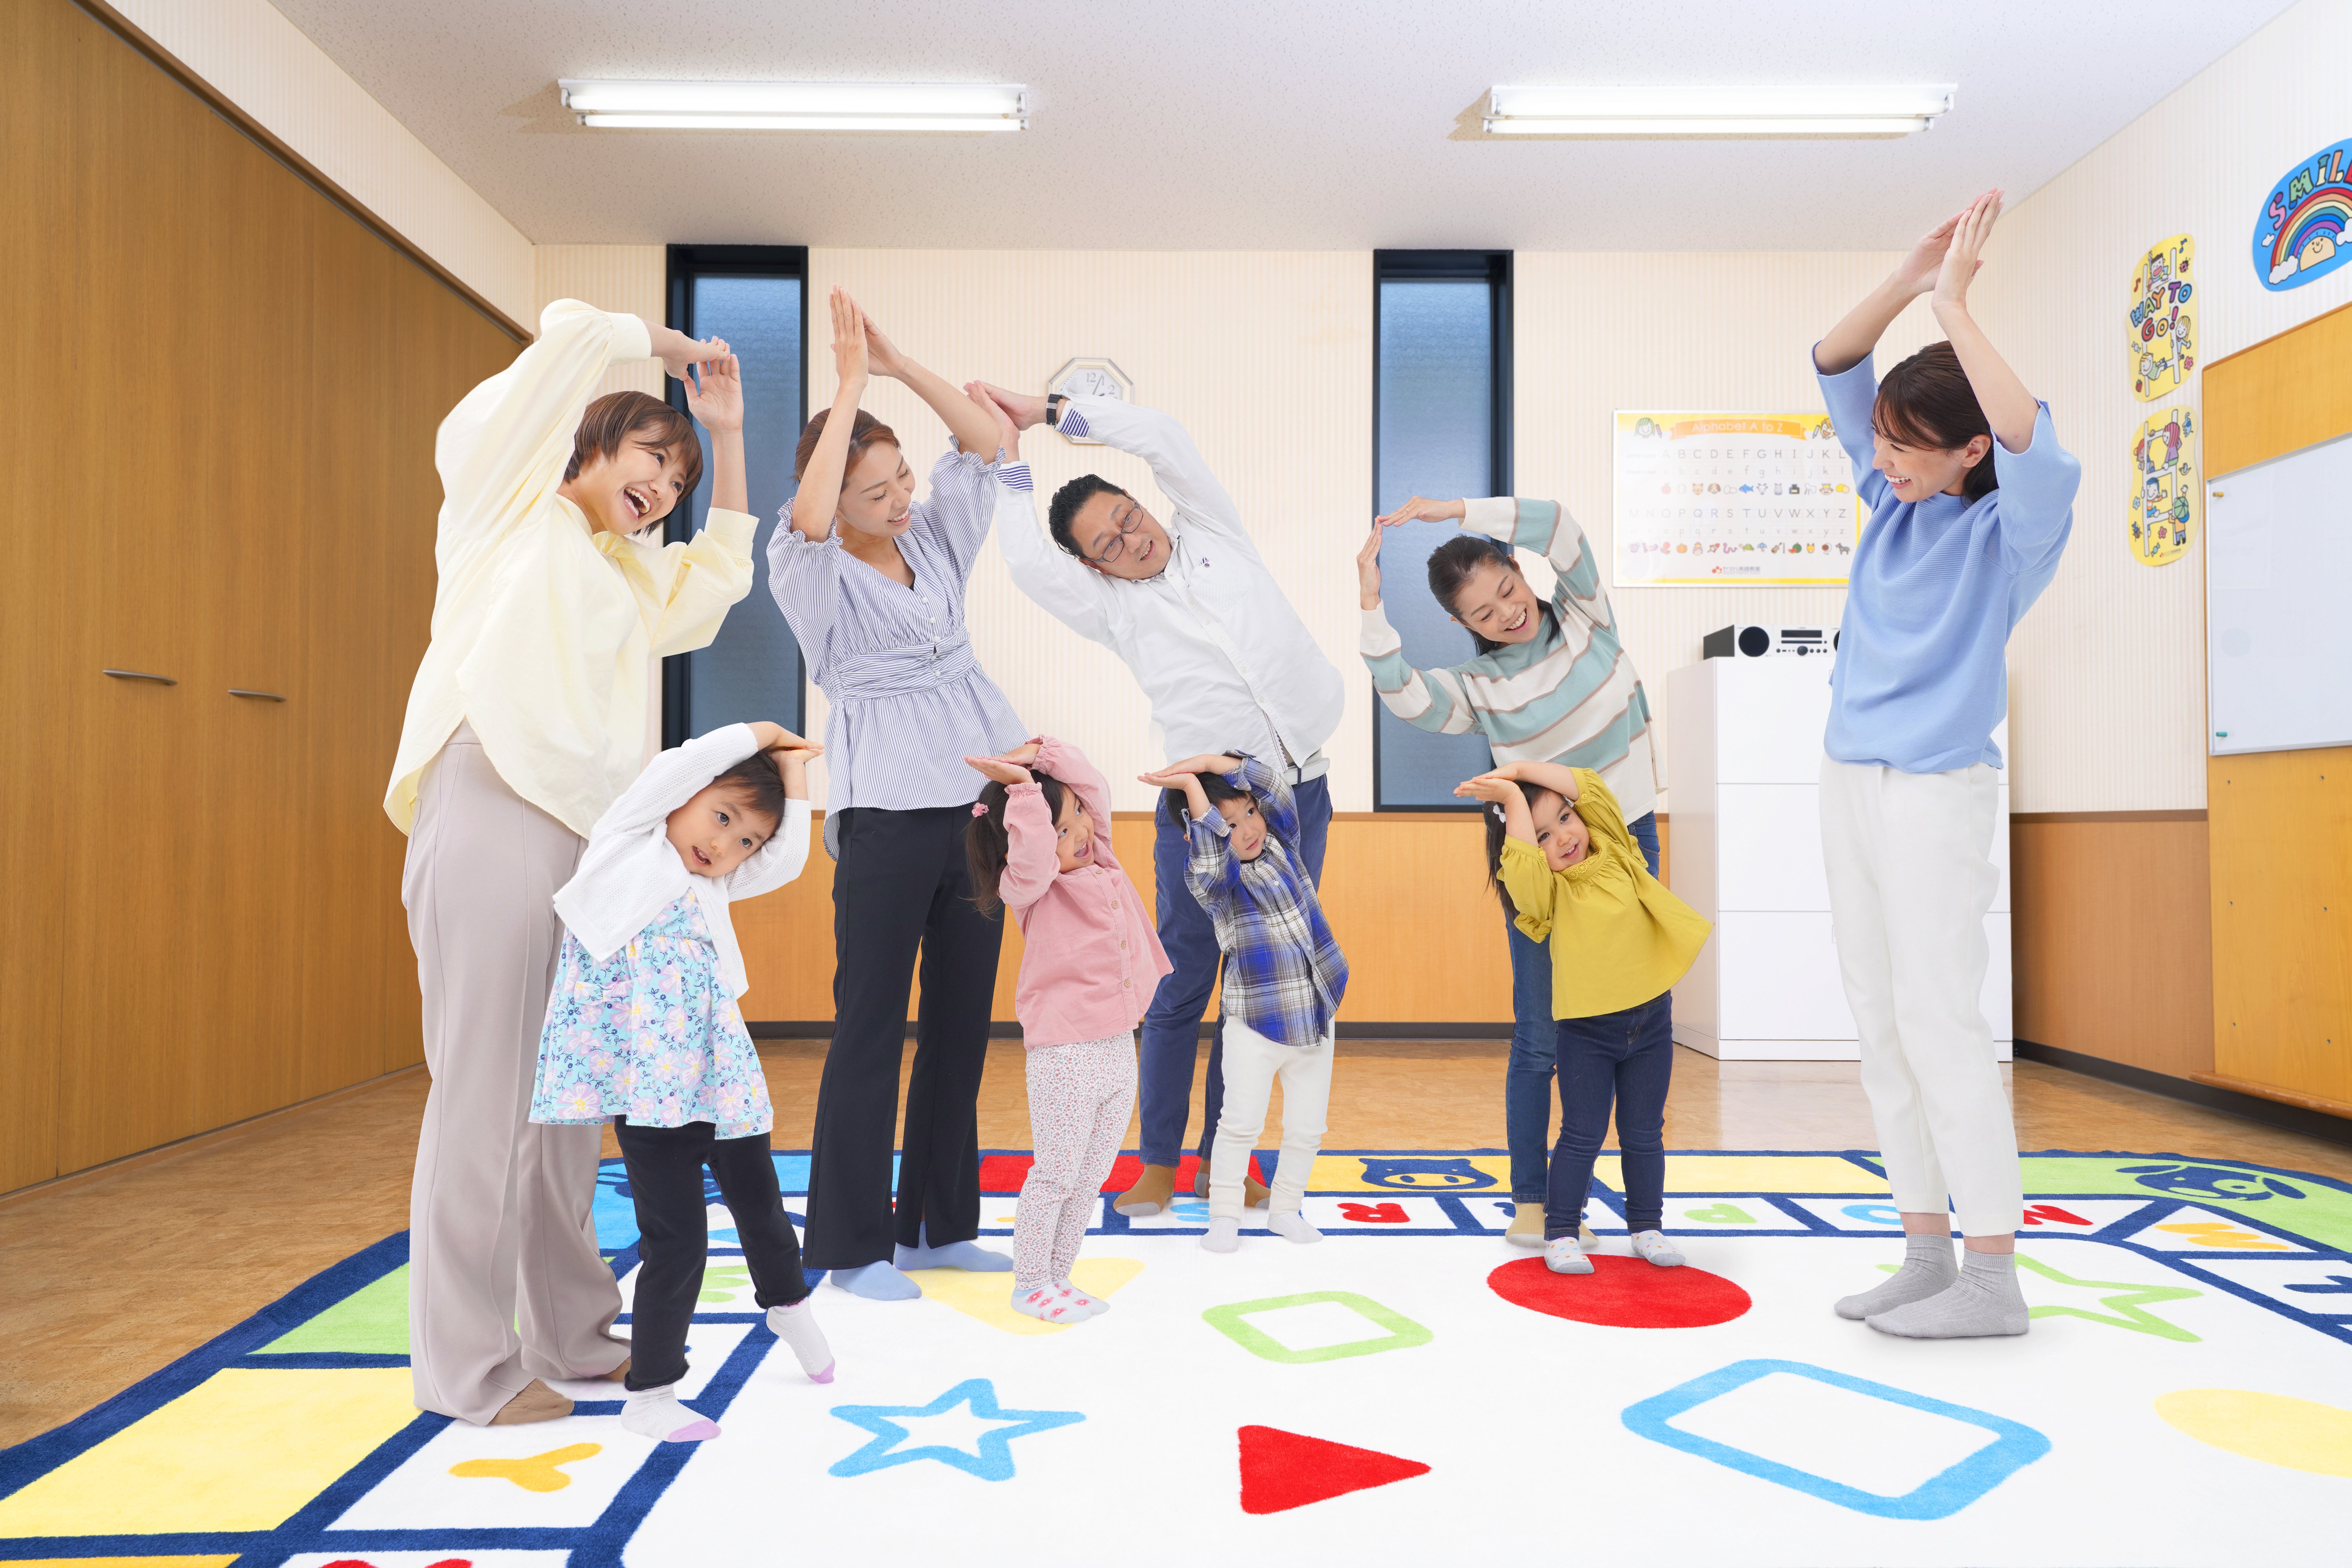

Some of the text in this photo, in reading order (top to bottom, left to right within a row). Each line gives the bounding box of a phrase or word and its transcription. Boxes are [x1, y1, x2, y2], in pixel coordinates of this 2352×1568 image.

[2130, 281, 2192, 328] WAY TO
[2141, 305, 2179, 342] GO!
[1086, 372, 1096, 382] 12
[1108, 385, 1115, 394] 2
[1692, 421, 1783, 432] Alphabet A to Z
[1662, 450, 1671, 459] A
[1678, 449, 1686, 459] B
[1693, 449, 1702, 459] C
[1710, 449, 1719, 459] D
[1727, 449, 1733, 459] E
[1743, 449, 1750, 458] F
[1757, 449, 1767, 459] G
[1775, 450, 1782, 458] H
[1807, 449, 1813, 459] J
[1822, 450, 1830, 459] K
[1839, 450, 1846, 459] L
[1679, 466, 1685, 475] b
[1711, 466, 1717, 475] d
[1744, 465, 1749, 474] f
[1759, 469, 1765, 479] g
[1775, 466, 1781, 475] h
[1807, 467, 1813, 479] j
[1823, 466, 1828, 475] k
[1629, 508, 1846, 518] M N O P Q R S T U V W X Y Z
[1679, 528, 1685, 538] p
[1695, 528, 1700, 538] q
[1824, 529, 1829, 538] y
[1337, 1203, 1411, 1223] R
[448, 1443, 603, 1492] Y
